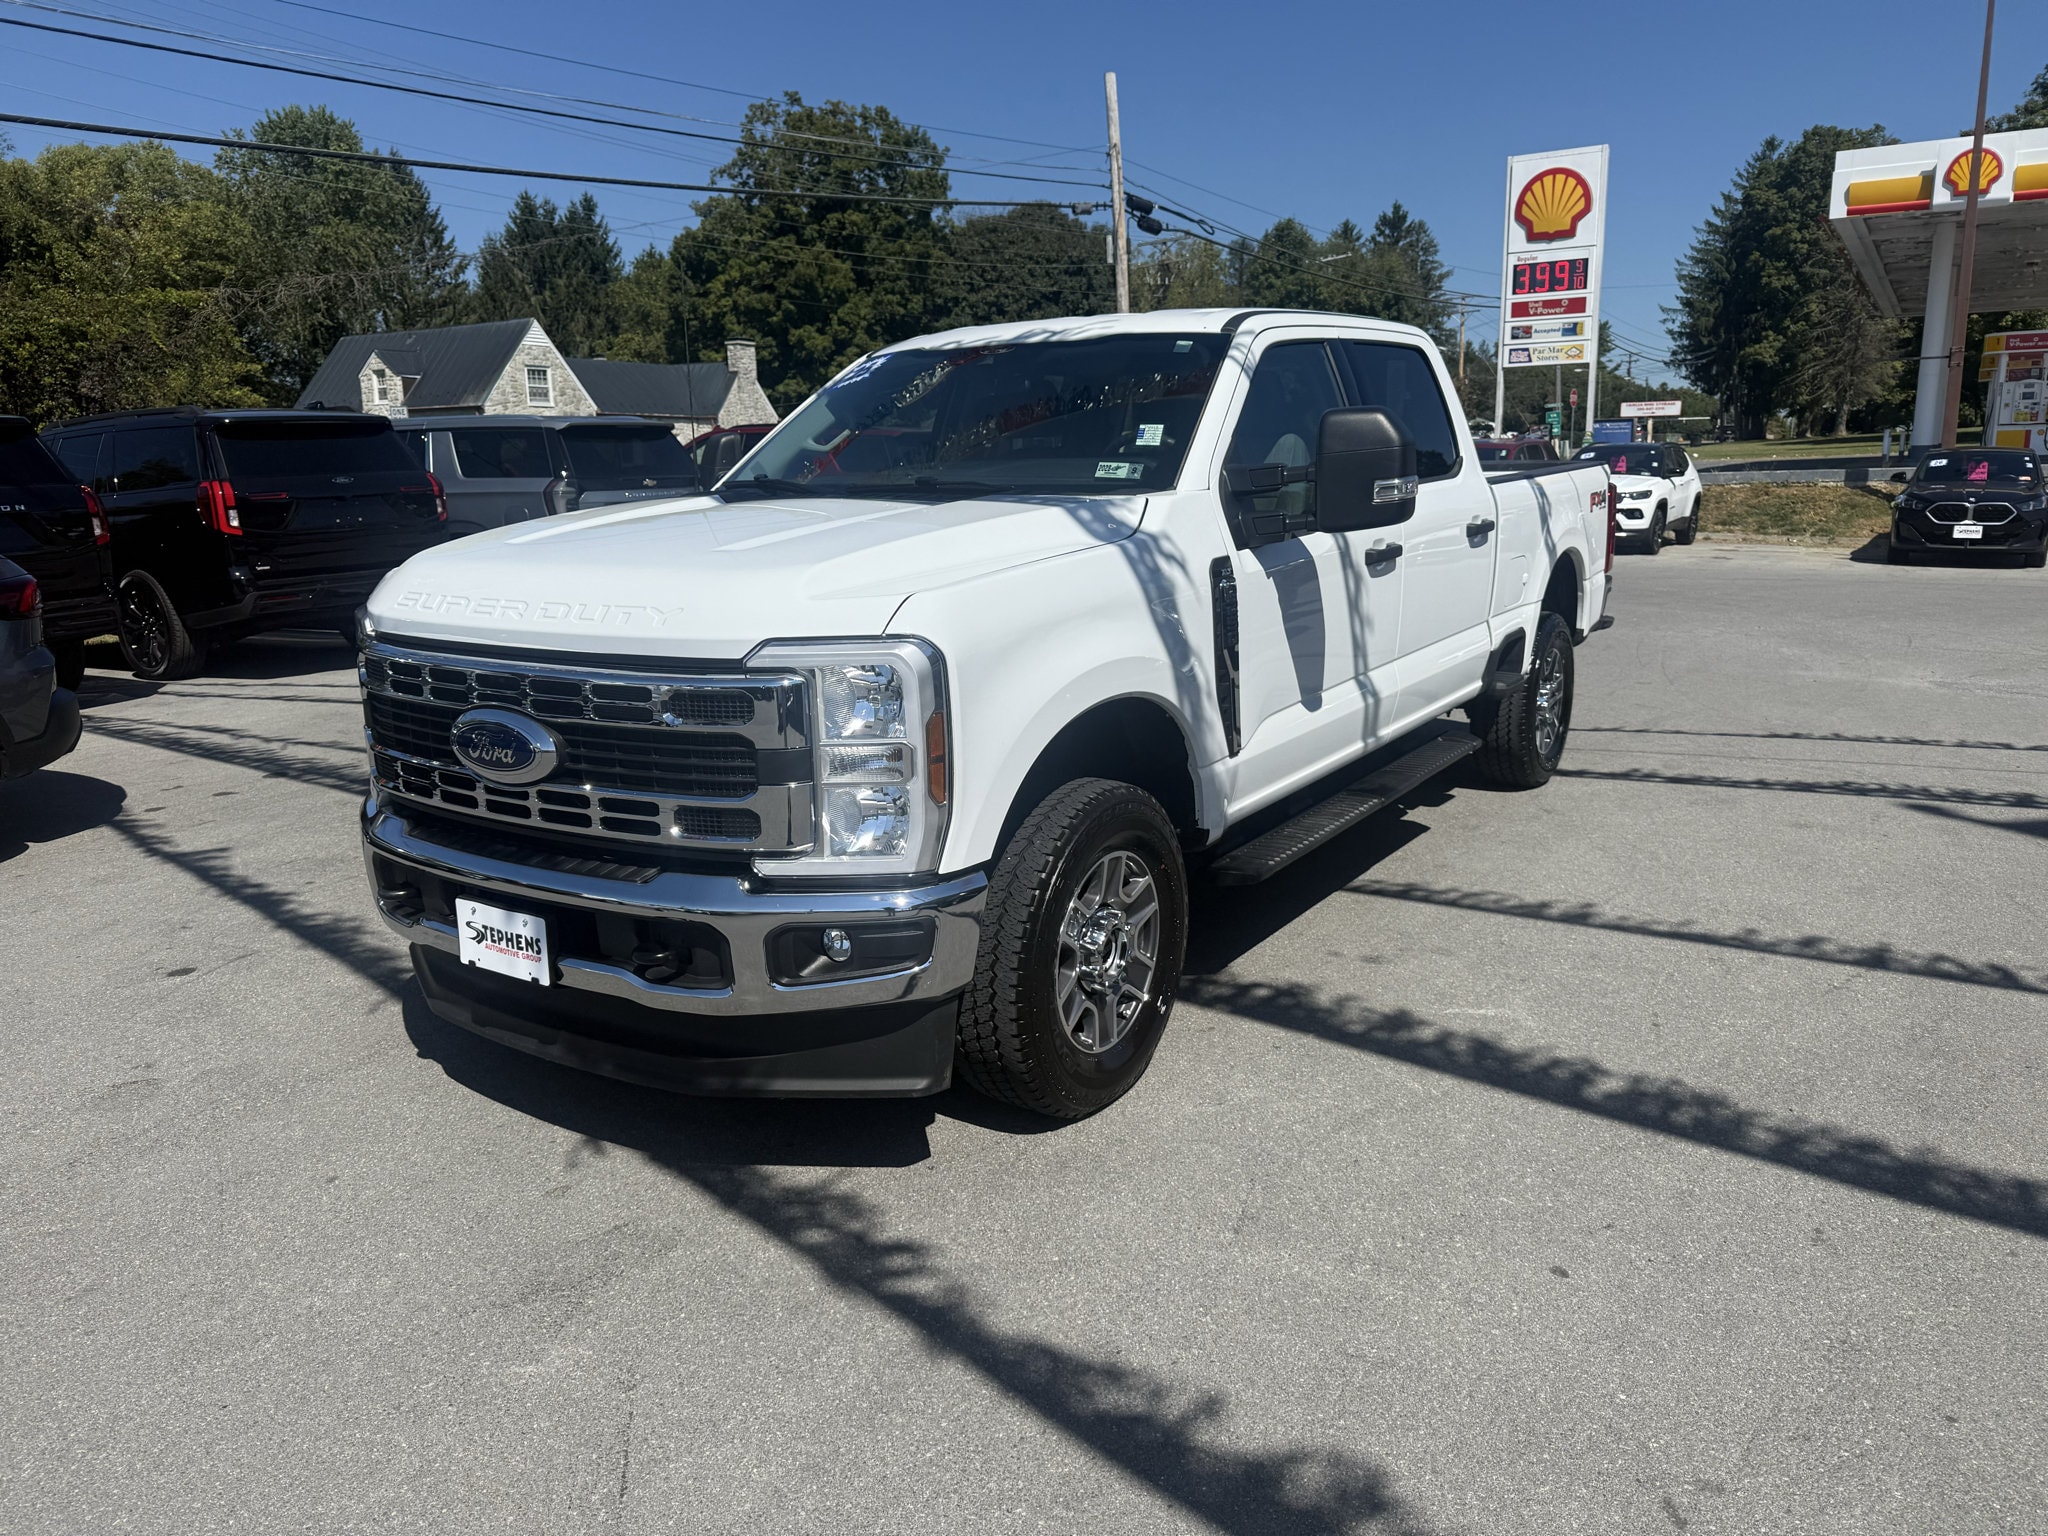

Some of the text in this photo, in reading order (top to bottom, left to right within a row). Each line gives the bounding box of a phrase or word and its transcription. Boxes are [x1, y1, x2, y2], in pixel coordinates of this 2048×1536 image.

[1517, 255, 1538, 263] Regular
[1515, 261, 1570, 294] 3.99
[1528, 300, 1543, 308] Shell
[1529, 306, 1566, 315] V-Power
[1532, 347, 1546, 355] Par
[1548, 346, 1565, 354] Mar
[1590, 489, 1606, 512] FX4
[395, 591, 685, 628] SUPER DUTY
[467, 730, 517, 765] Ford
[465, 920, 543, 956] STEPHENS
[484, 942, 542, 963] AUTOMOTIVE GROUP
